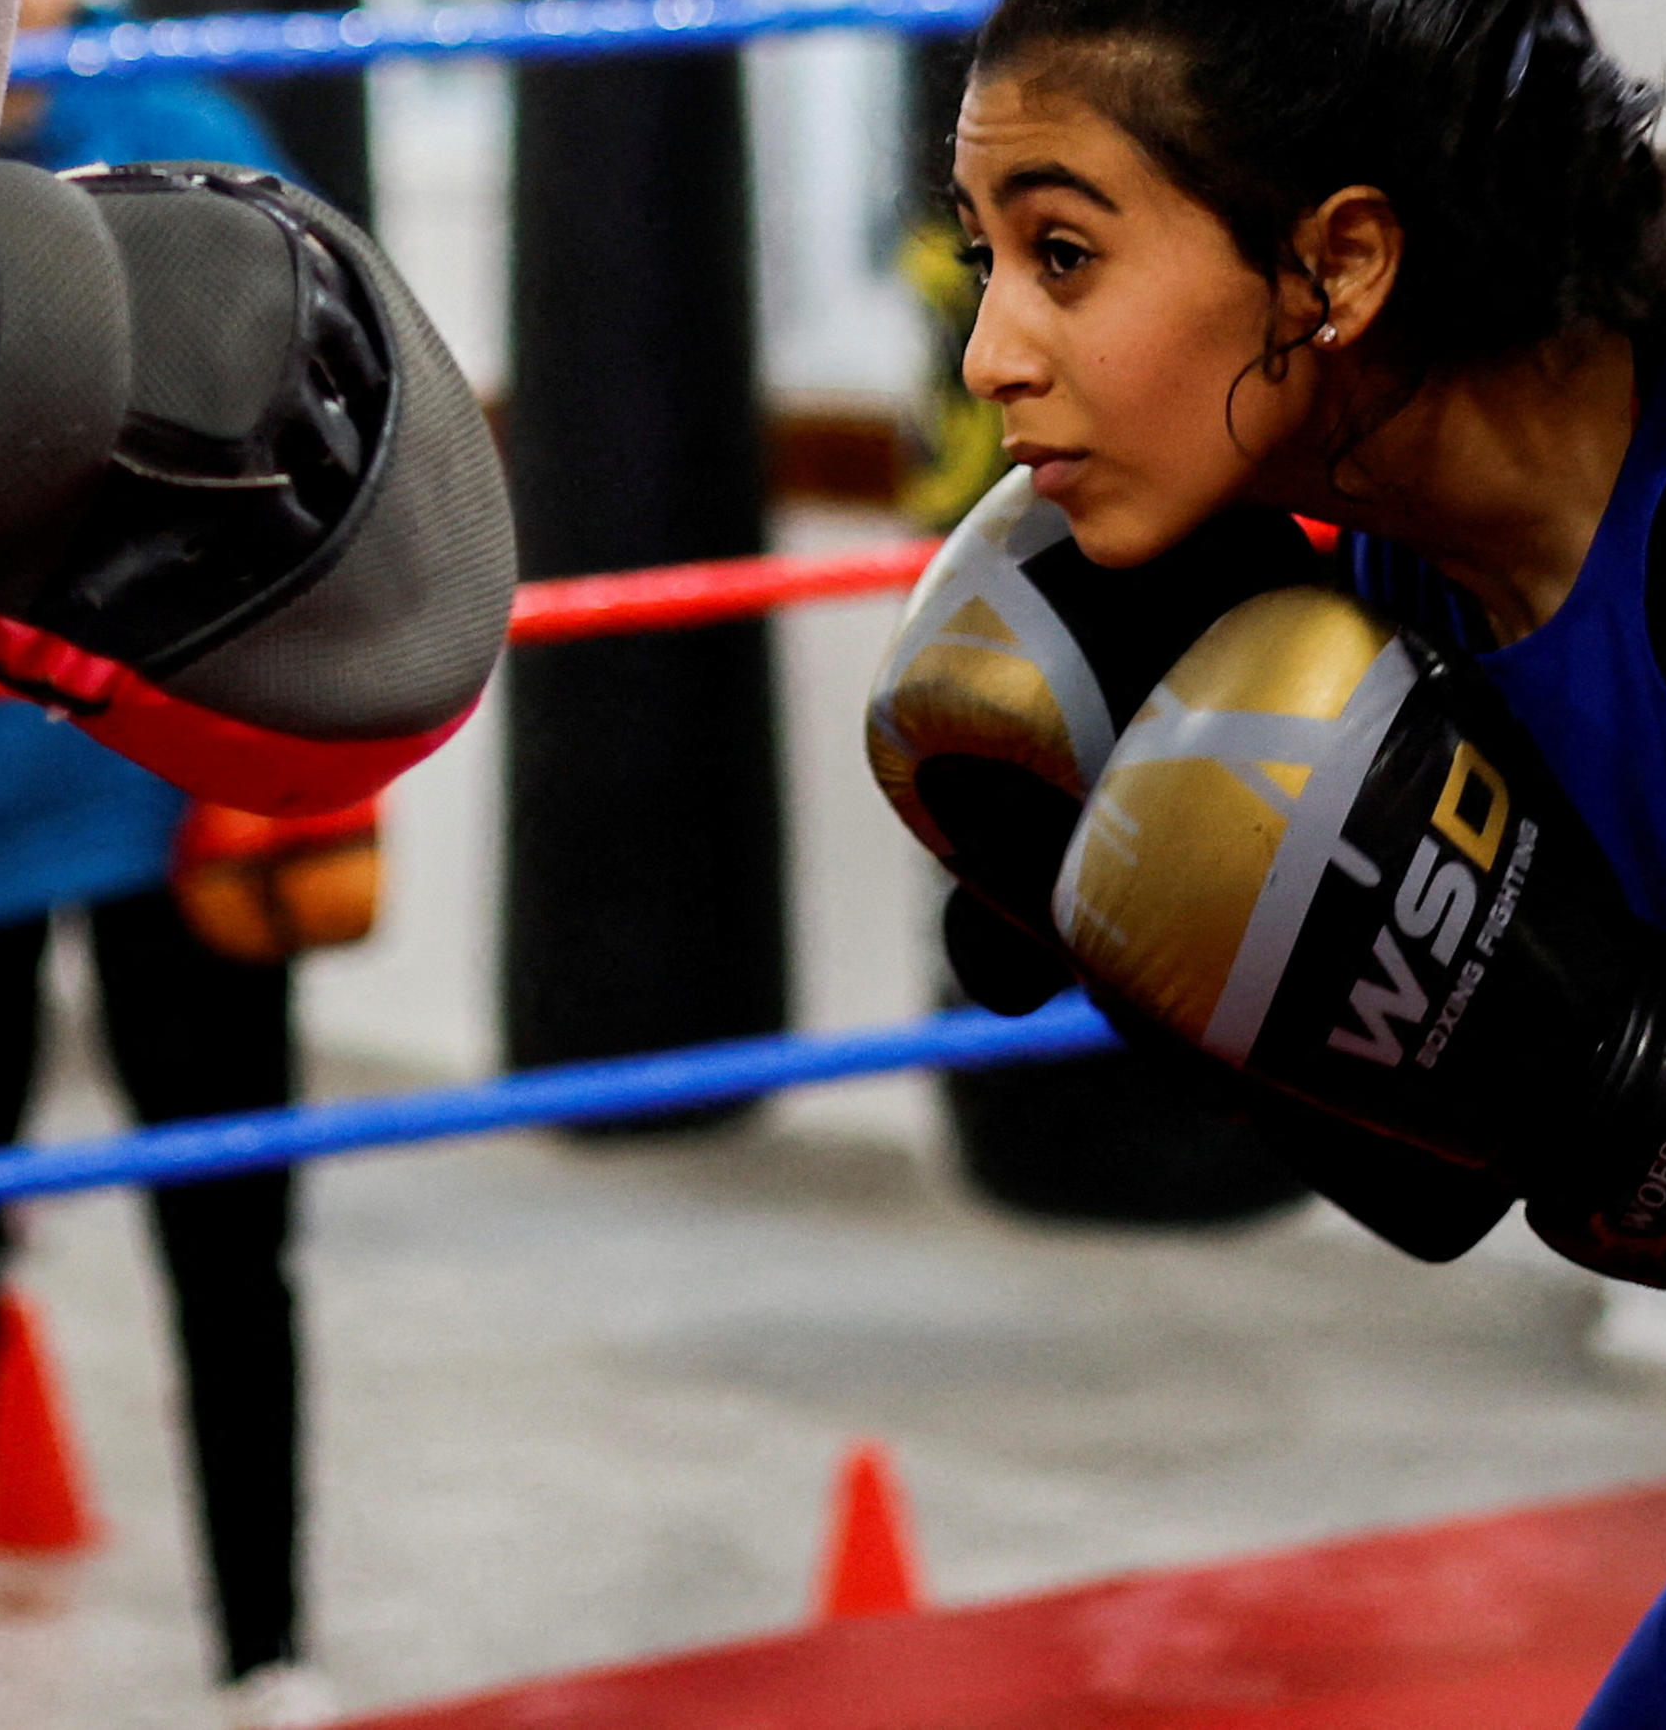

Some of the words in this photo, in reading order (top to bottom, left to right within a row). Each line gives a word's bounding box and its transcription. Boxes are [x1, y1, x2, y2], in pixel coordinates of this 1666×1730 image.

[1327, 739, 1510, 1068] WSD
[1415, 960, 1484, 1069] BOXING
[1475, 818, 1538, 957] FIGHTING
